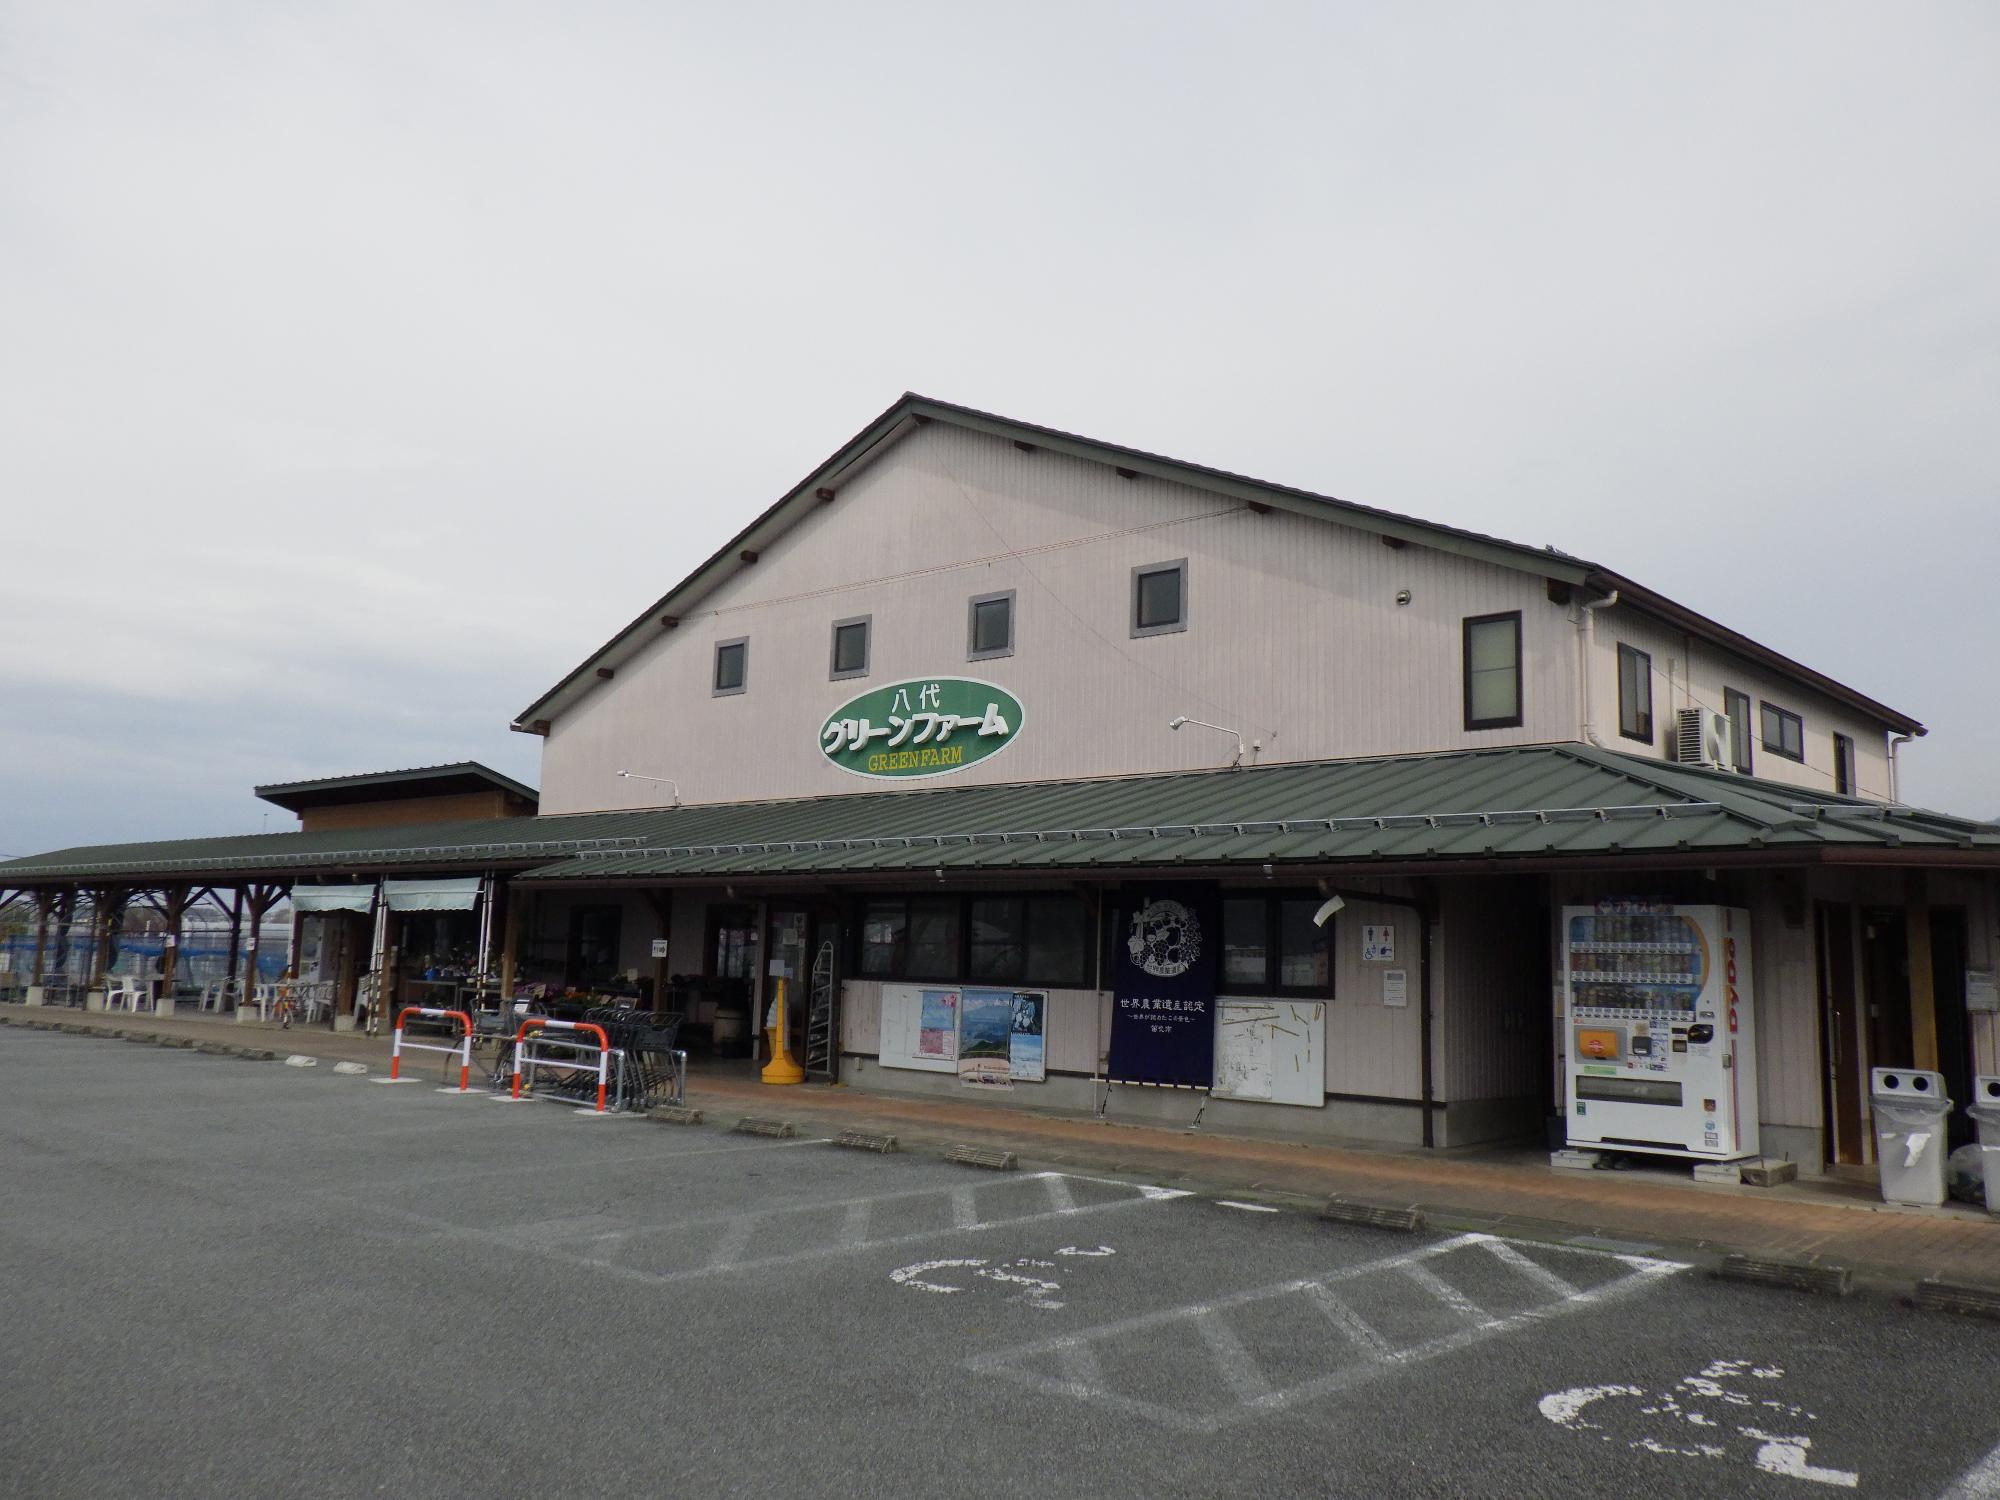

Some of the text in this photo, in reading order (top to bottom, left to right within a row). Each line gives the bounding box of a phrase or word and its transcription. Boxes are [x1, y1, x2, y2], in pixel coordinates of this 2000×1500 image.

[891, 683, 941, 714] 八代
[822, 702, 1010, 755] グリーンファーム
[1120, 998, 1205, 1012] 世界農業遺産認定
